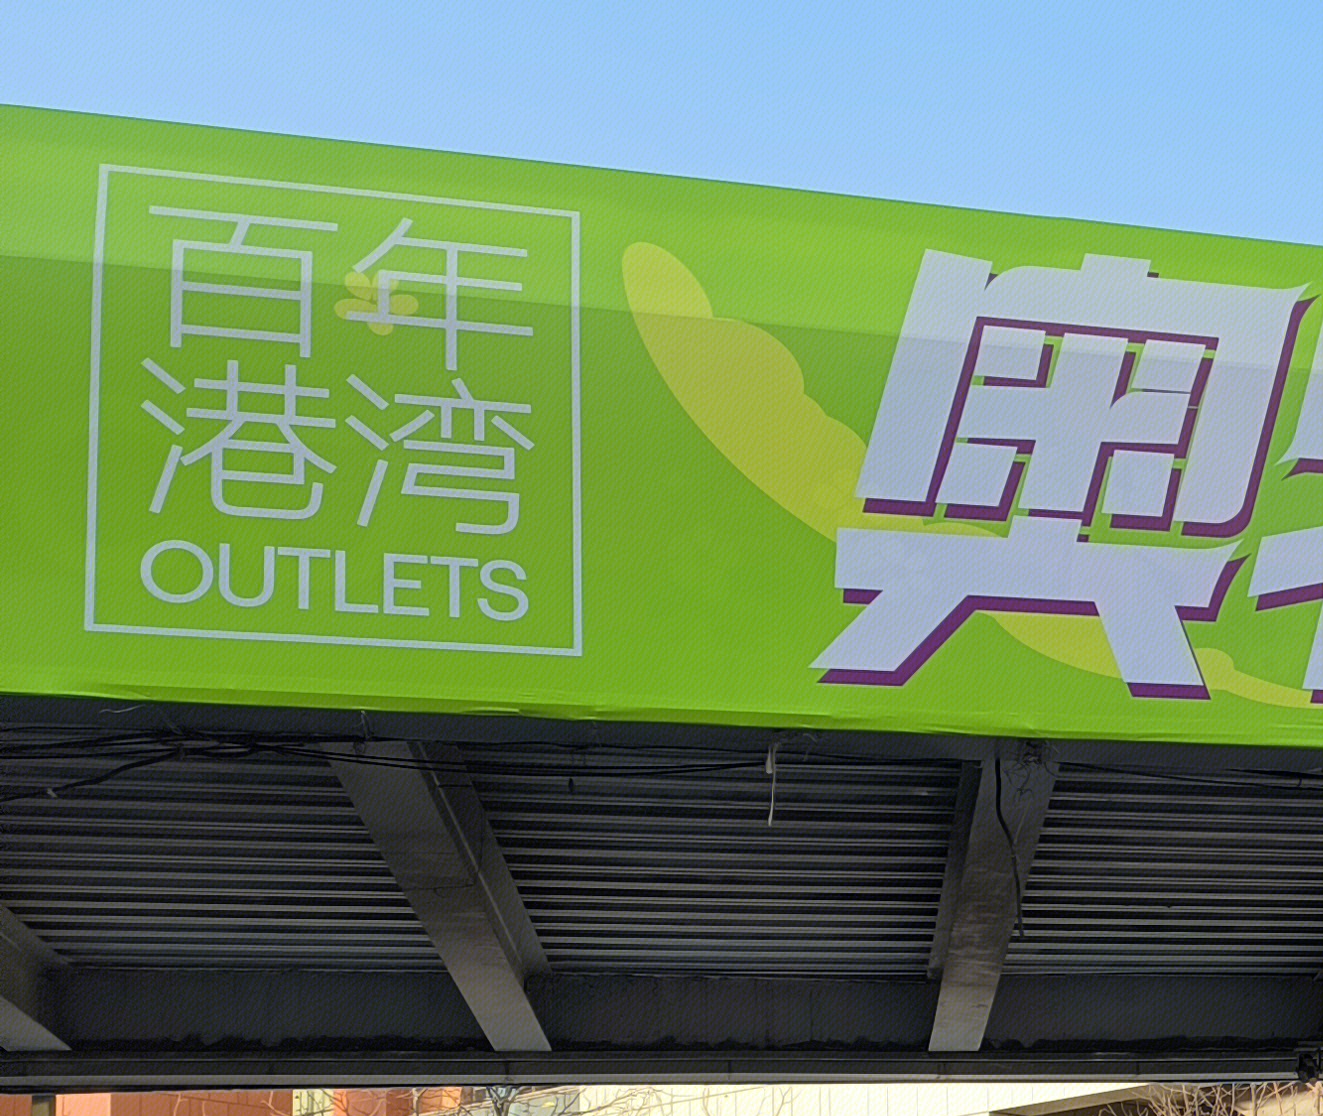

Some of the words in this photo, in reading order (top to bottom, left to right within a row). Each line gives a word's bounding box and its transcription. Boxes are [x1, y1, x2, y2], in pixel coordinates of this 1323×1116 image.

[148, 203, 535, 371] 百年
[140, 357, 535, 536] 港湾
[140, 538, 529, 622] OUTLETS
